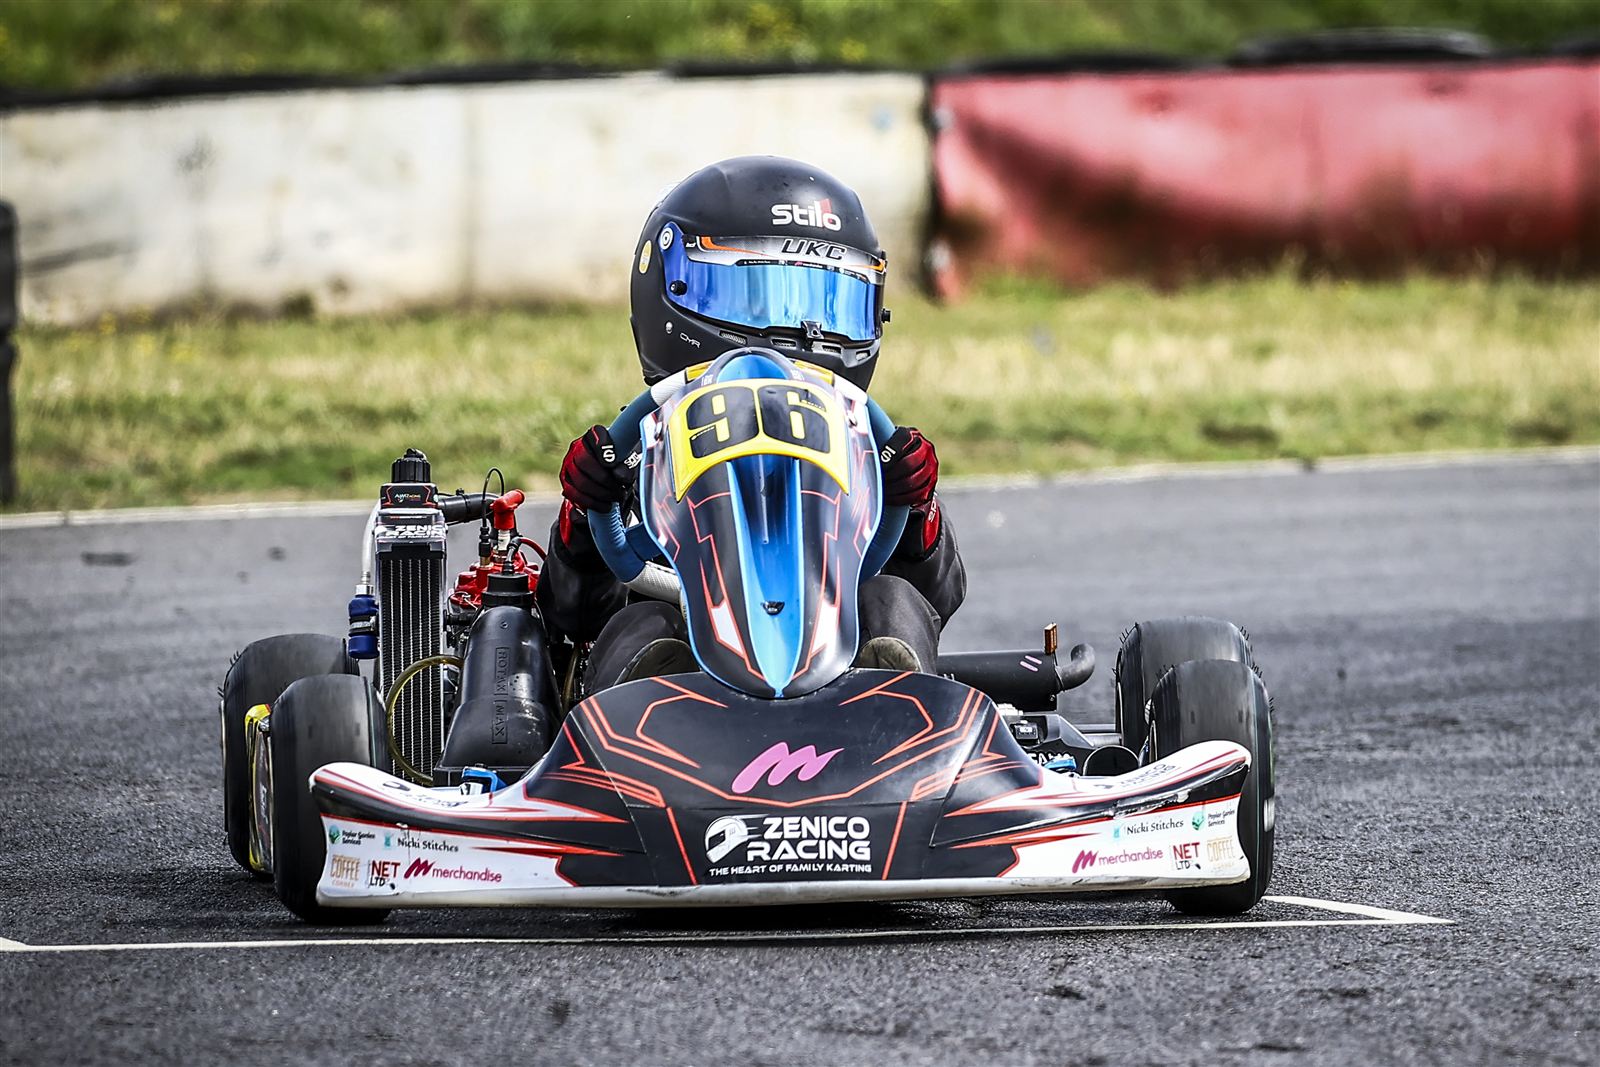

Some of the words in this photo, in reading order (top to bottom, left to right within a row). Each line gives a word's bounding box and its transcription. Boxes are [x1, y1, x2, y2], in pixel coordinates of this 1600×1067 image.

[771, 198, 842, 231] Stilo
[781, 238, 846, 260] UKC
[686, 385, 831, 459] 96
[497, 650, 508, 692] ROTAX
[494, 704, 505, 737] MAX
[762, 815, 871, 840] ZENICO
[1127, 821, 1149, 835] Nicki
[1150, 818, 1184, 832] Stitches
[397, 837, 420, 849] Nicki
[422, 839, 459, 853] Stitches
[746, 839, 872, 862] RACING
[1172, 841, 1201, 860] NET
[1206, 838, 1236, 862] COFFEE
[1099, 846, 1164, 867] merchandise
[1175, 860, 1191, 870] LTD
[330, 857, 361, 881] COFFEE
[371, 859, 401, 878] NET
[432, 863, 502, 883] merchandise
[709, 867, 730, 877] THE
[731, 865, 767, 875] HEART
[768, 864, 784, 874] OF
[785, 863, 823, 873] FAMILY
[826, 863, 872, 873] KARTING
[369, 876, 387, 887] LTD
